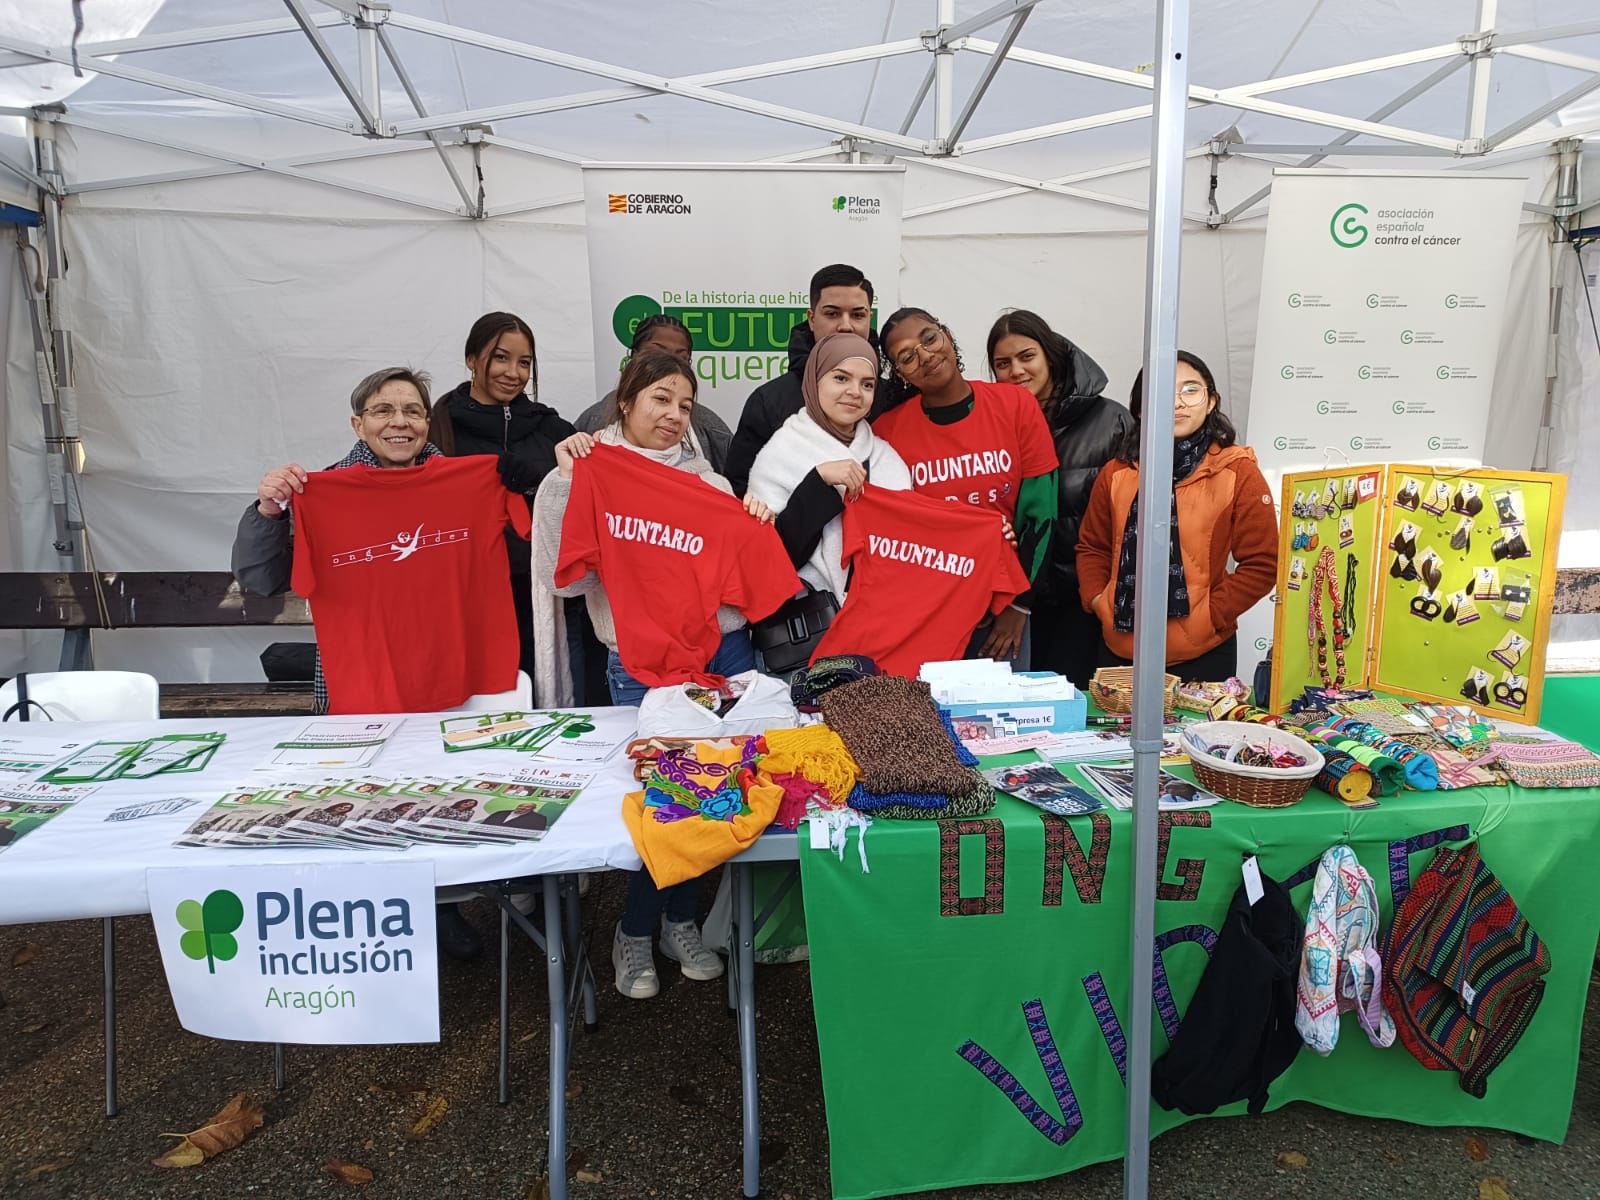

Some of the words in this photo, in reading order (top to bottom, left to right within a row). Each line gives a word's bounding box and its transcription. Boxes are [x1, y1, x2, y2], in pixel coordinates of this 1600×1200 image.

[628, 194, 683, 204] GOBIERNO
[848, 196, 881, 207] Plena
[628, 204, 643, 214] DE
[646, 204, 691, 214] ARAGON
[1377, 208, 1434, 219] asociación
[1376, 222, 1424, 234] española
[1374, 236, 1409, 245] contra
[1411, 235, 1421, 245] el
[1423, 235, 1461, 245] cáncer
[662, 291, 681, 304] De
[685, 291, 698, 304] la
[702, 291, 755, 304] historia
[759, 294, 785, 306] que
[682, 312, 808, 348] FUTU
[605, 511, 704, 556] OLUNTARIO
[868, 534, 975, 578] VOLUNTARIO
[1042, 715, 1052, 723] 1€
[514, 775, 583, 786] diferencias
[937, 808, 1212, 917] ONG
[257, 887, 414, 941] Plena
[258, 939, 413, 975] inclusión
[265, 984, 356, 1015] Aragón
